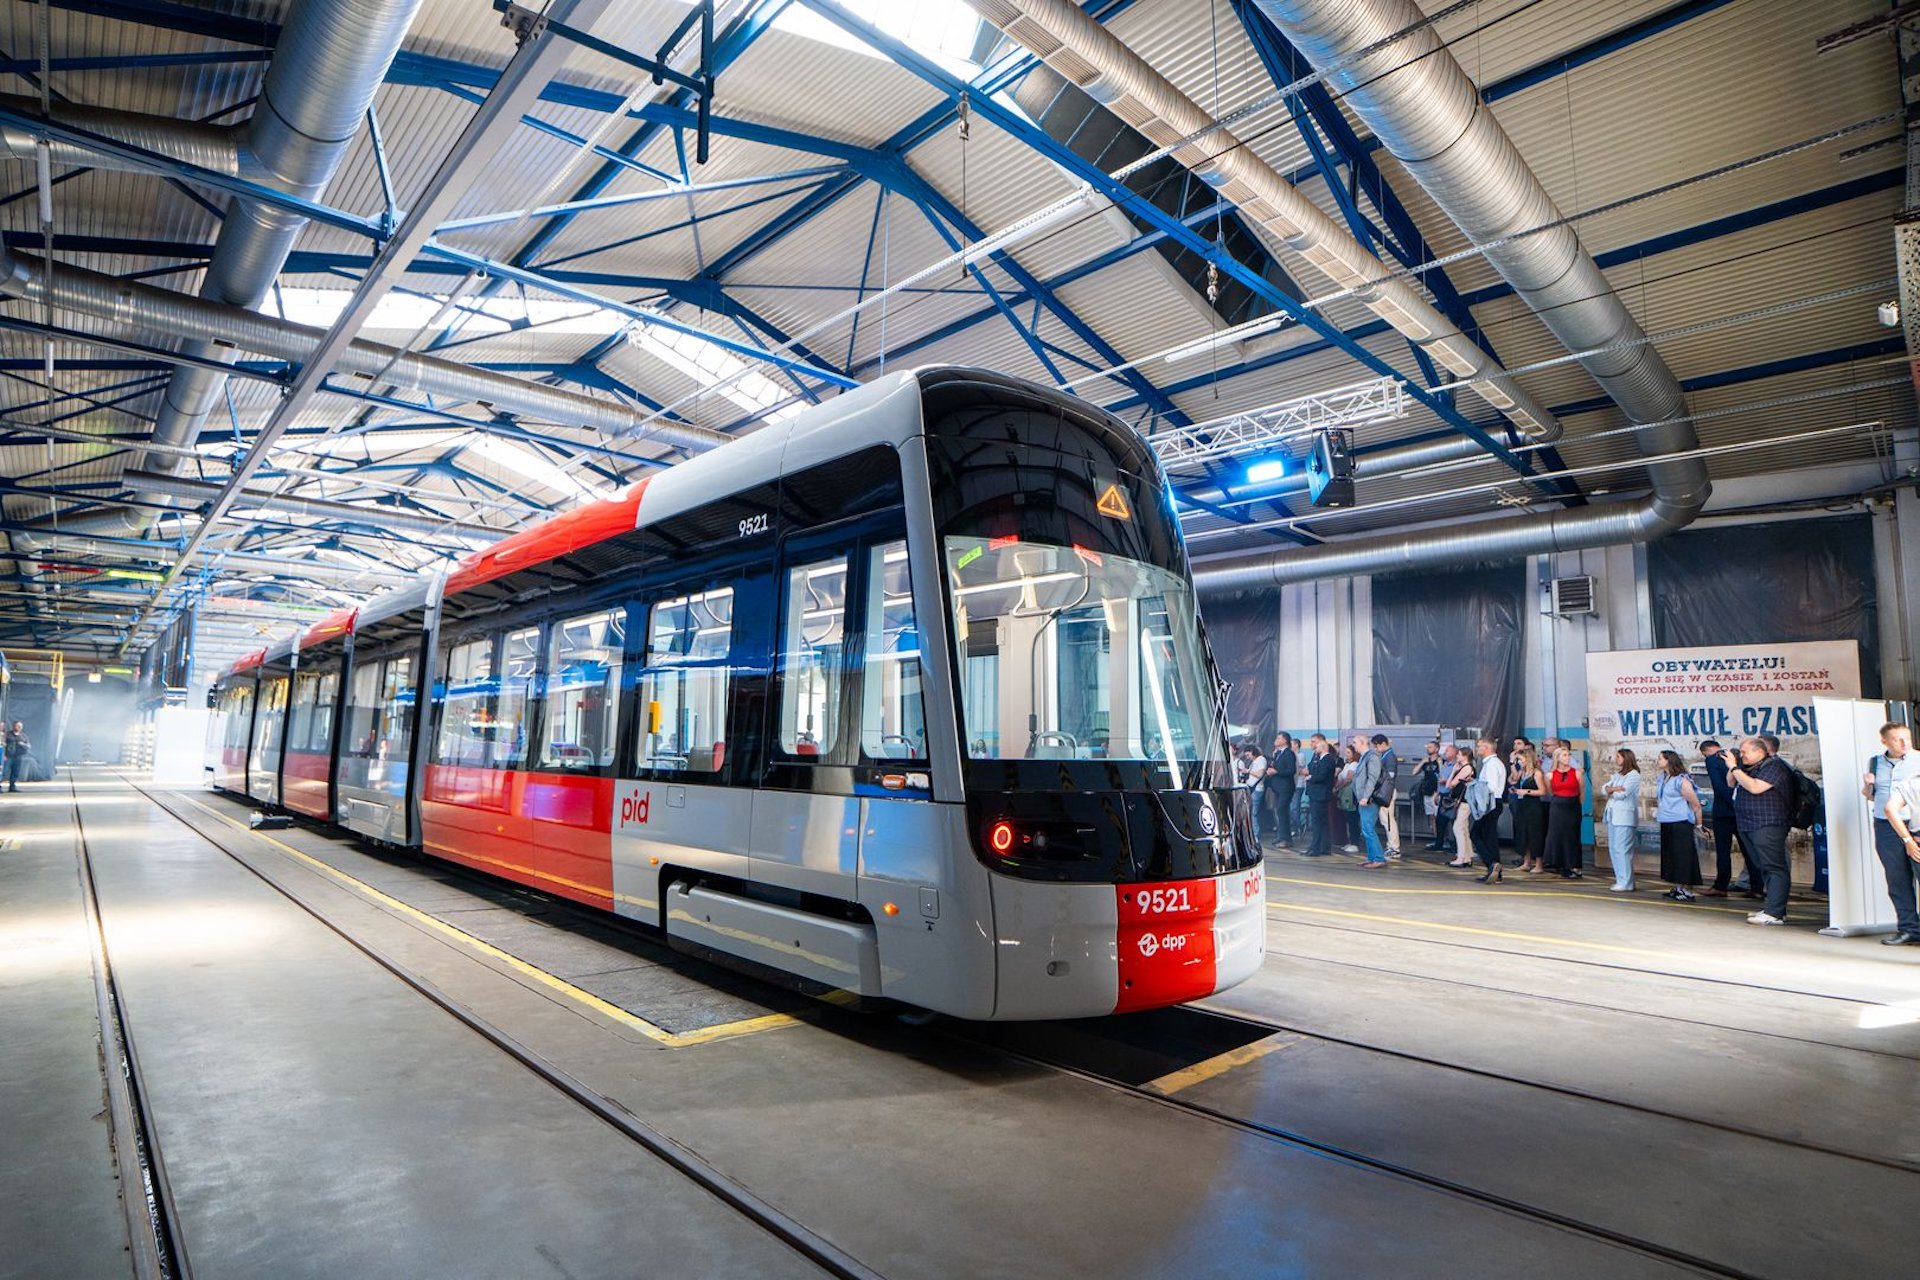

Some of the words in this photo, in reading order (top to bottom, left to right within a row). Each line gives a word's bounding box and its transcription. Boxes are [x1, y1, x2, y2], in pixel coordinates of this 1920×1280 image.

[738, 513, 769, 538] 9521
[1616, 675, 1661, 685] COFNIJ
[1664, 675, 1685, 685] SIĘ
[1688, 674, 1702, 682] W
[1706, 672, 1754, 682] CZASIE
[1763, 672, 1768, 680] I
[1773, 668, 1830, 680] ZOSTAŃ
[1651, 657, 1786, 673] OBYWATELU!
[1614, 685, 1706, 694] MOTORNICZYM
[1711, 683, 1785, 693] KONSTALA
[1789, 682, 1835, 691] 102NA
[1617, 707, 1732, 736] WEHIKUŁ
[621, 788, 650, 829] pid
[1243, 870, 1261, 905] pid
[1137, 887, 1191, 914] 9521
[1161, 933, 1187, 951] dpp
